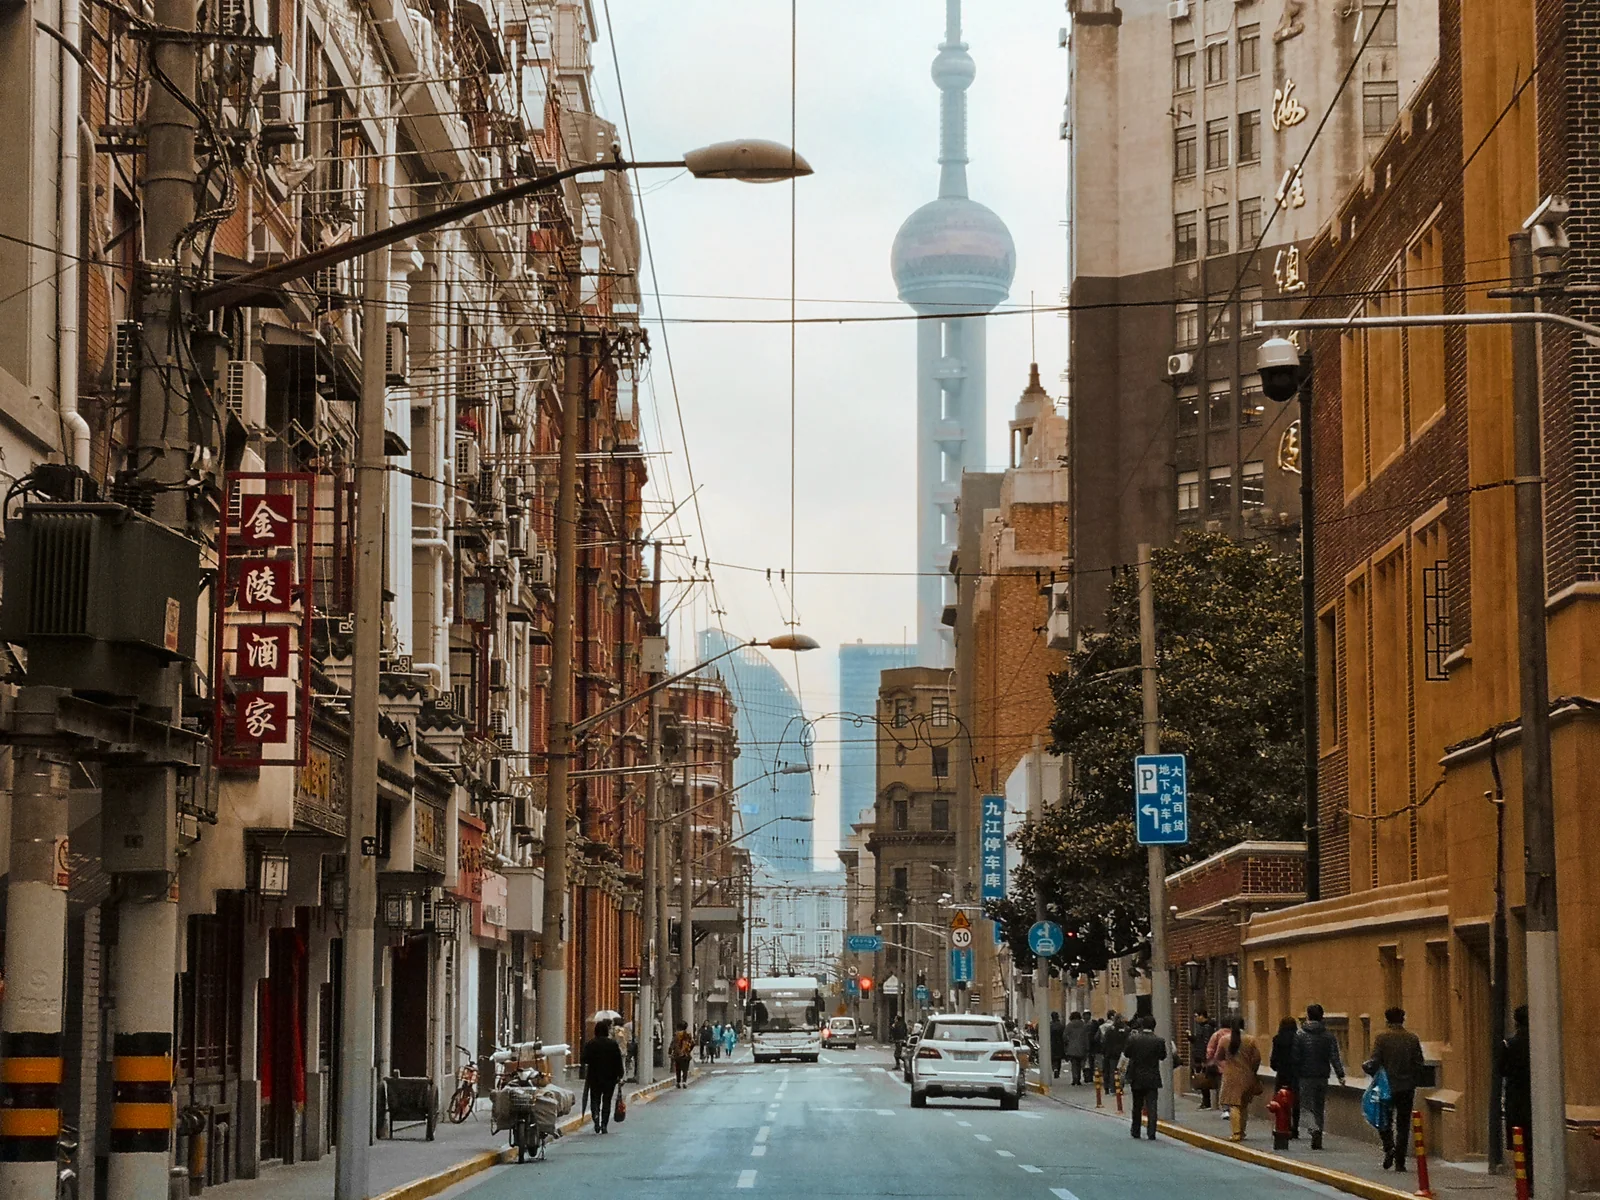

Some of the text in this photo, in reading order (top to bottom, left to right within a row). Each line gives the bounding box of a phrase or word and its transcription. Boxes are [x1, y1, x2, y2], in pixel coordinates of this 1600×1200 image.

[245, 500, 288, 738] 金陵酒家
[1141, 769, 1154, 791] P
[1158, 763, 1172, 834] 地下停车库
[1171, 765, 1184, 832] 大丸百货
[955, 931, 969, 942] 30
